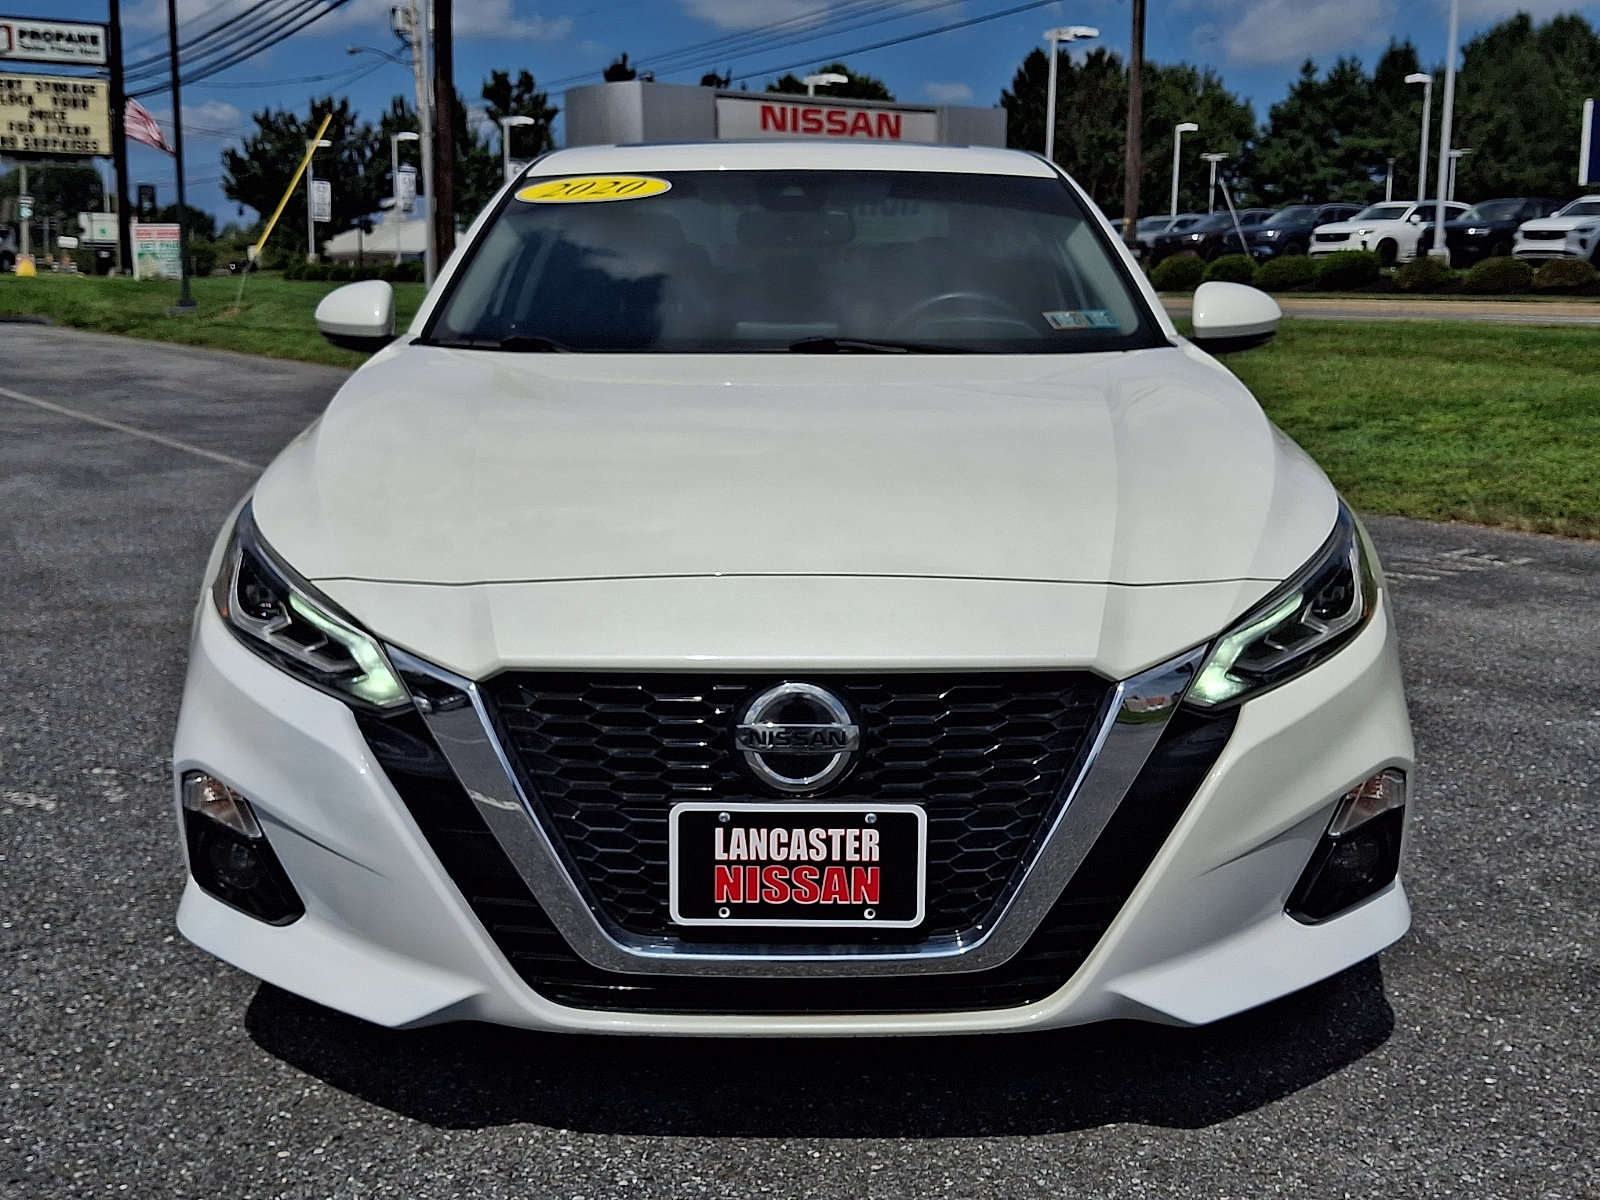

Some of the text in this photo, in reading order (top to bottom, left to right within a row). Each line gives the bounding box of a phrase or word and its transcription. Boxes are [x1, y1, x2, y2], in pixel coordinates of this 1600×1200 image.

[19, 28, 99, 46] PROPANE
[760, 104, 902, 140] NISSAN
[537, 179, 648, 199] 2020
[750, 730, 846, 747] NISSAN
[714, 827, 880, 861] LANCASTER
[714, 865, 880, 905] NISSAN
